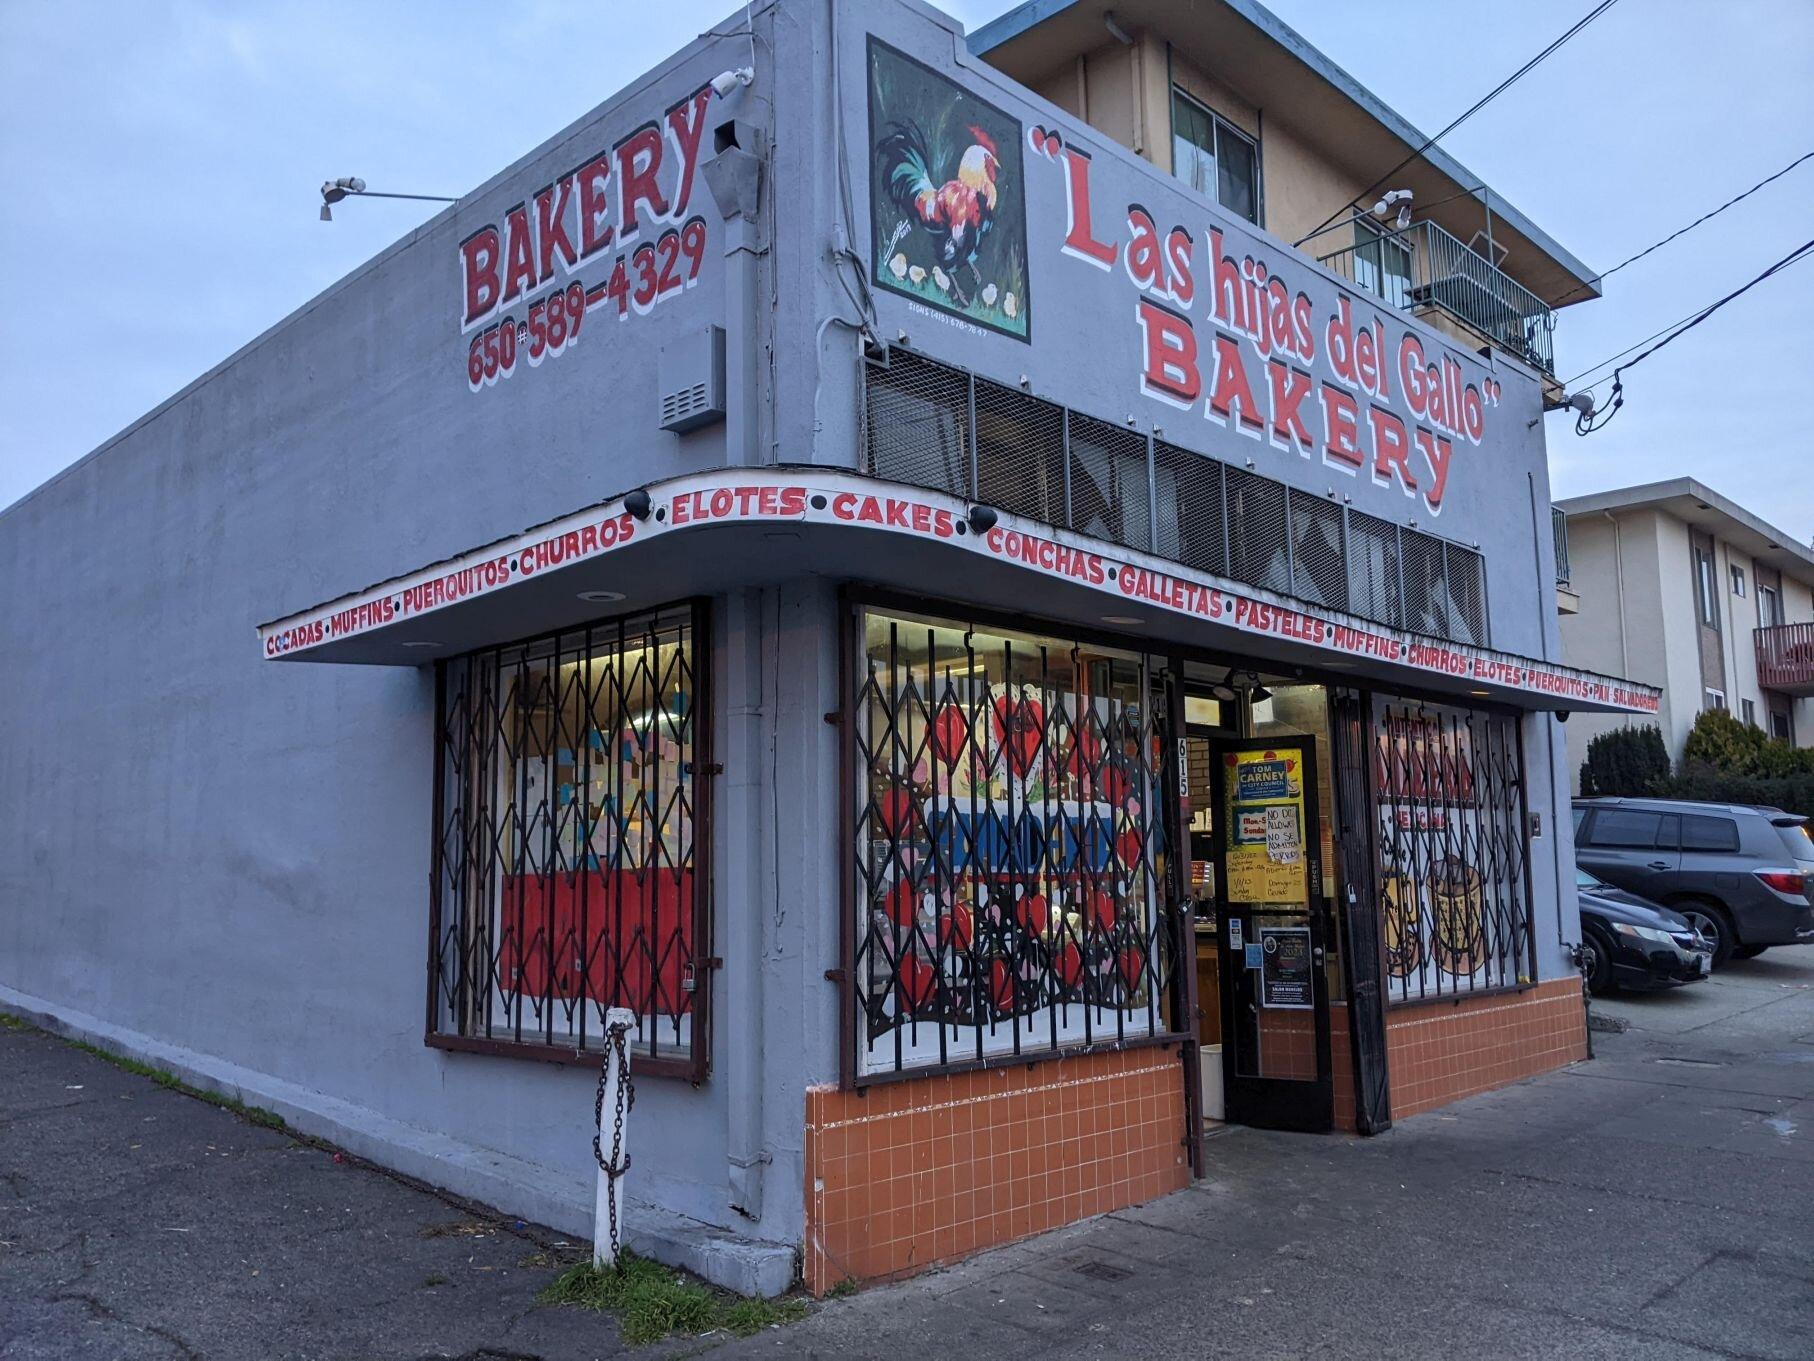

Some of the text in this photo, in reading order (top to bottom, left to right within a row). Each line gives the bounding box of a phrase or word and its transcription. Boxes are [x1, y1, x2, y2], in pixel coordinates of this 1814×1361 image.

[460, 80, 713, 333] BAKERY
[1207, 224, 1315, 367] hijas
[1325, 292, 1390, 404] del
[1136, 294, 1452, 518] BAKERY
[330, 597, 394, 637] MUFFINS
[403, 555, 509, 615] PUERQUITOS
[520, 513, 634, 576] CHURROS
[671, 486, 807, 525] ELOTES
[832, 492, 955, 538] CAKES
[986, 525, 1106, 586] CONCHAS
[1119, 564, 1223, 619] GALLETAS
[1234, 597, 1325, 643] PASTELES
[1333, 623, 1399, 660] MUFFINS
[1407, 645, 1467, 675] CHURROS
[1473, 657, 1521, 685] ELOTES
[1528, 669, 1588, 698] PUERQUITOS
[1179, 739, 1188, 795] 615
[1240, 771, 1285, 783] CARNEY
[1252, 765, 1272, 773] TOM
[1243, 826, 1266, 835] Sunda
[1267, 809, 1278, 820] NO
